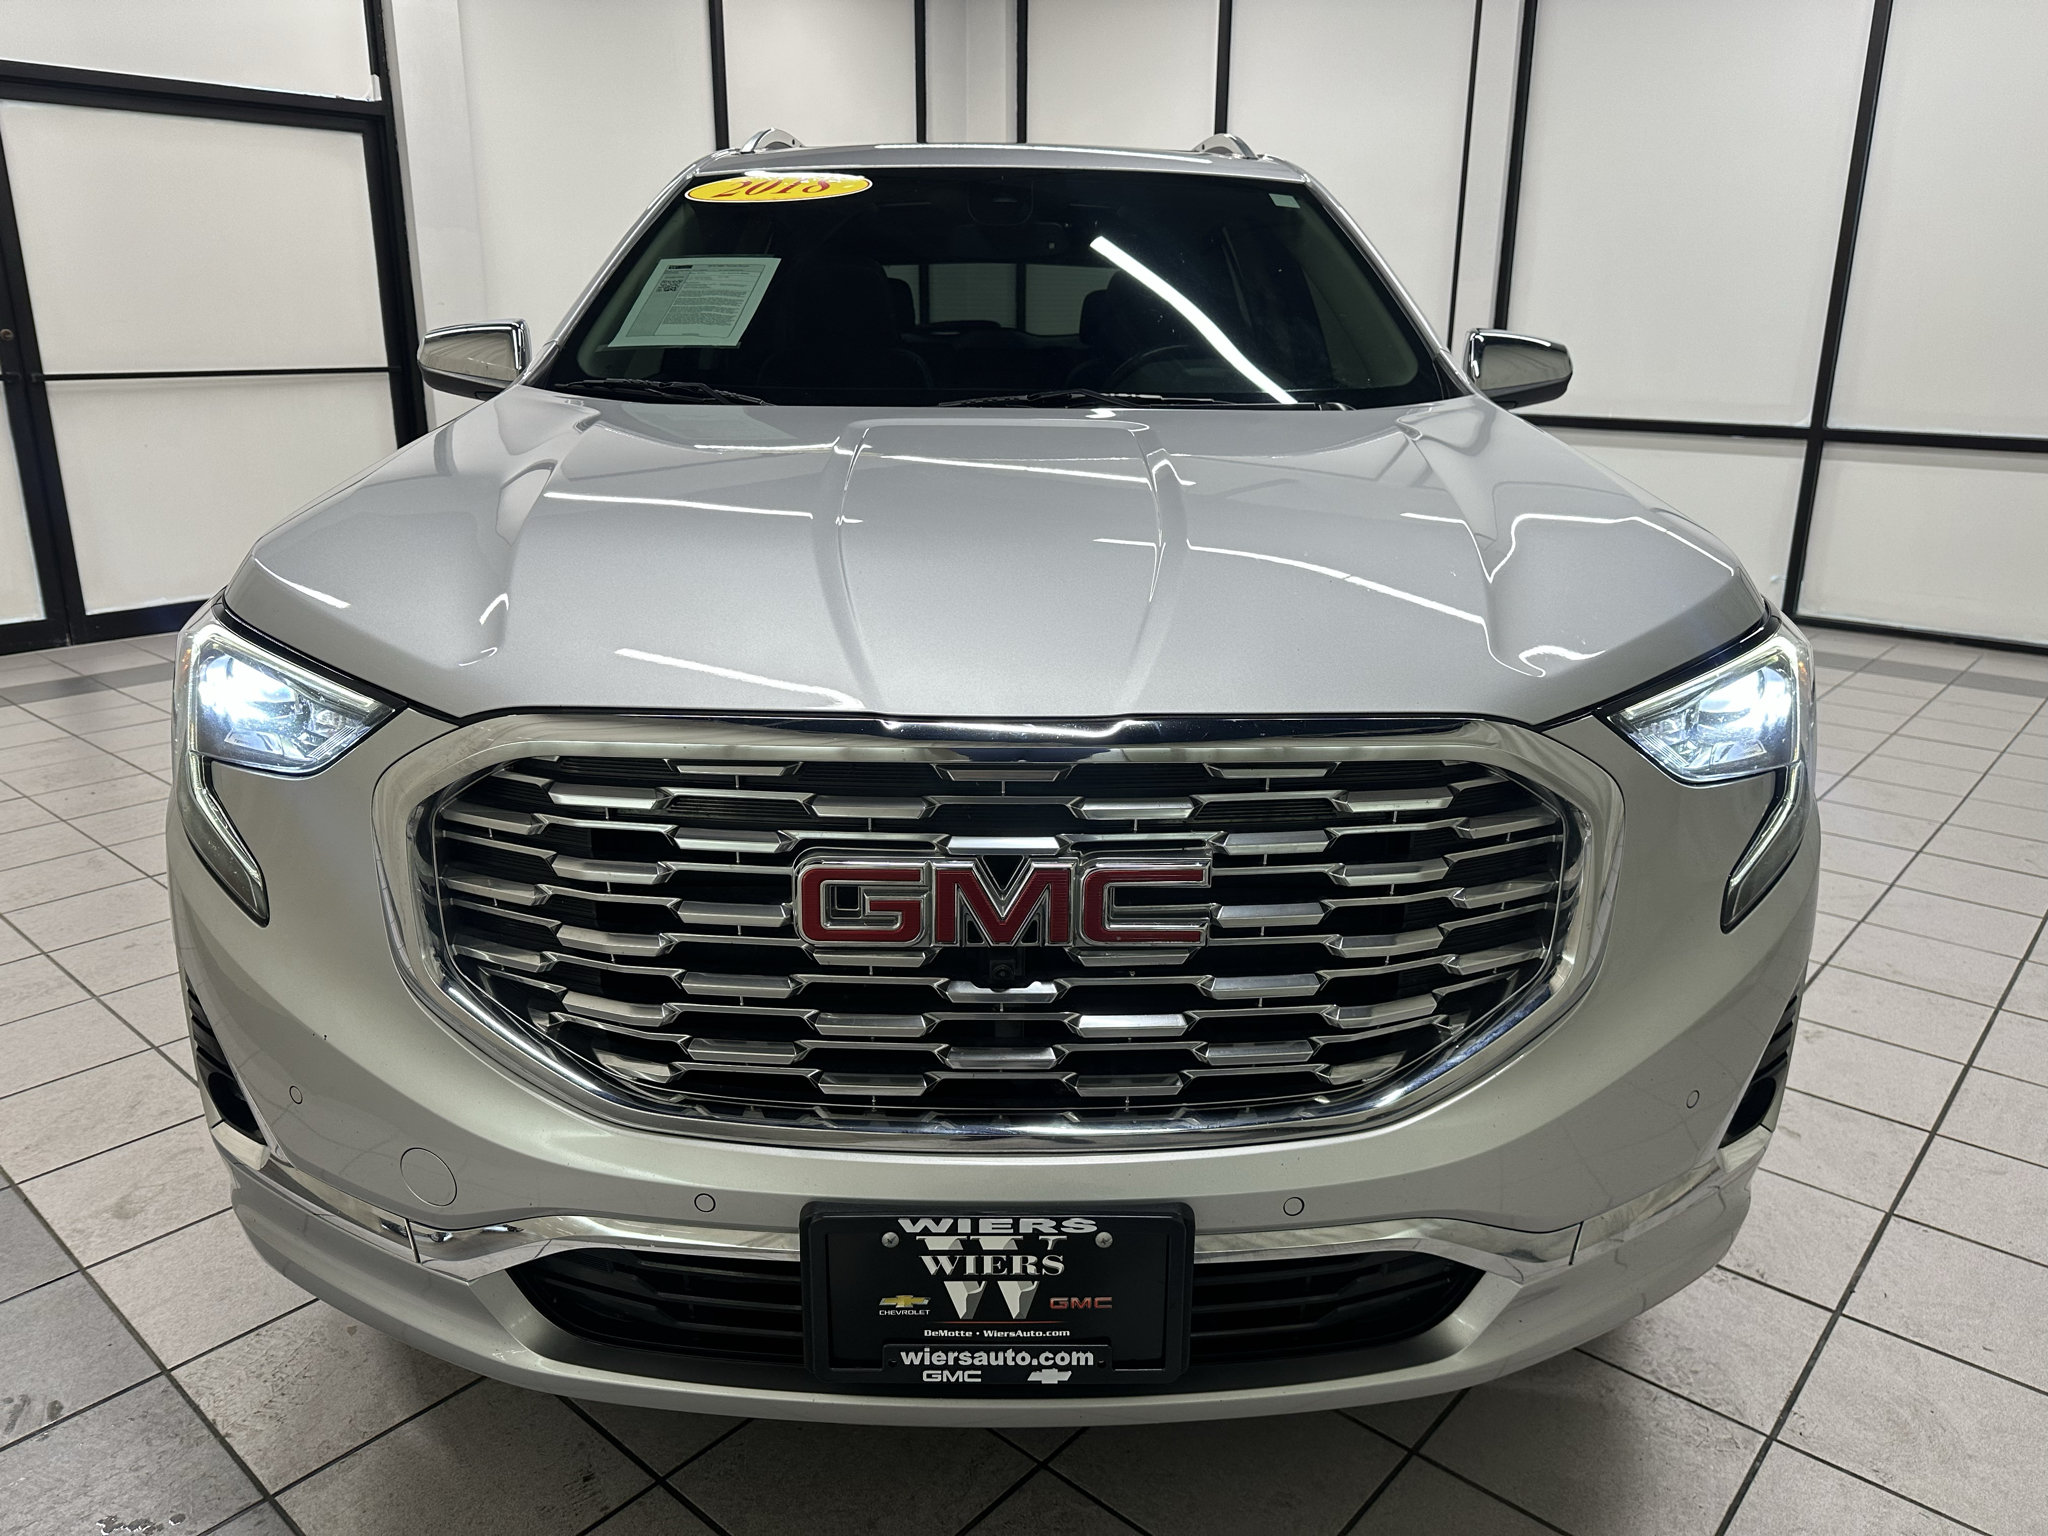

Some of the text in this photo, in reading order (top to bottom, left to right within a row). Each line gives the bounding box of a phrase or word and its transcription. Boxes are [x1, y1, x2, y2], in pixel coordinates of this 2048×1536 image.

[794, 855, 1211, 948] GMC
[898, 1218, 1098, 1233] WIERS
[919, 1255, 1065, 1276] WIERS
[1050, 1297, 1113, 1309] GMC
[924, 1329, 1070, 1337] DeMotte WiersAuto.com
[900, 1347, 1094, 1366] wiersauto.com
[922, 1370, 982, 1382] GMC
